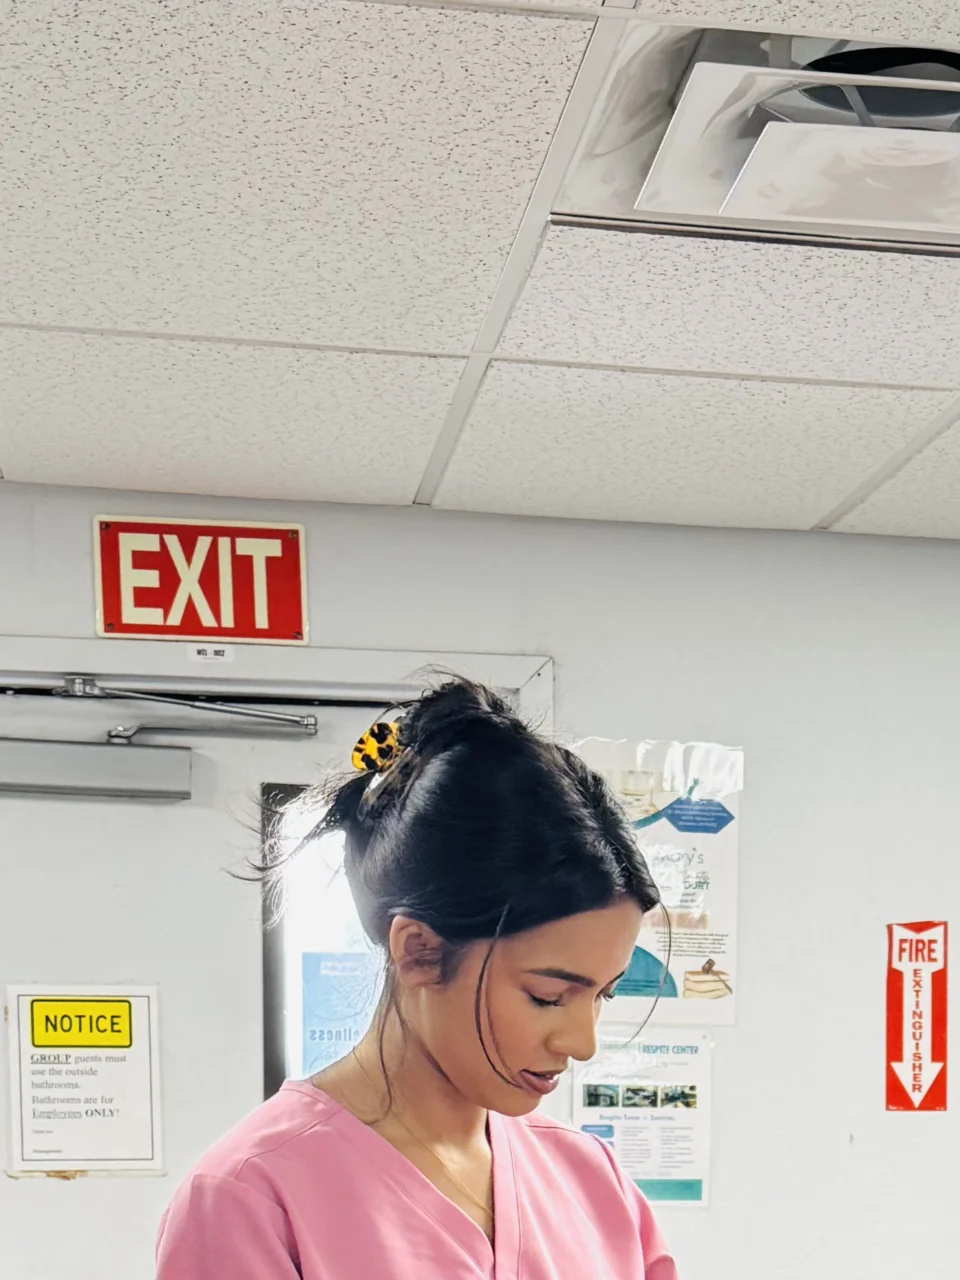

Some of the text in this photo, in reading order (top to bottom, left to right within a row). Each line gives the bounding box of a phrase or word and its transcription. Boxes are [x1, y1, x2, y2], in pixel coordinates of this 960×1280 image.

[118, 532, 282, 629] EXIT
[898, 939, 938, 962] FIRE
[45, 1014, 122, 1033] NOTICE
[911, 968, 923, 1093] EXTINGUISHER
[672, 1045, 699, 1055] CENTER
[30, 1054, 127, 1065] GROUP guests must
[48, 1067, 63, 1076] the
[65, 1067, 98, 1076] outside
[32, 1095, 82, 1104] Bathrooms
[101, 1095, 114, 1104] for
[32, 1108, 120, 1119] Employees ONLY!
